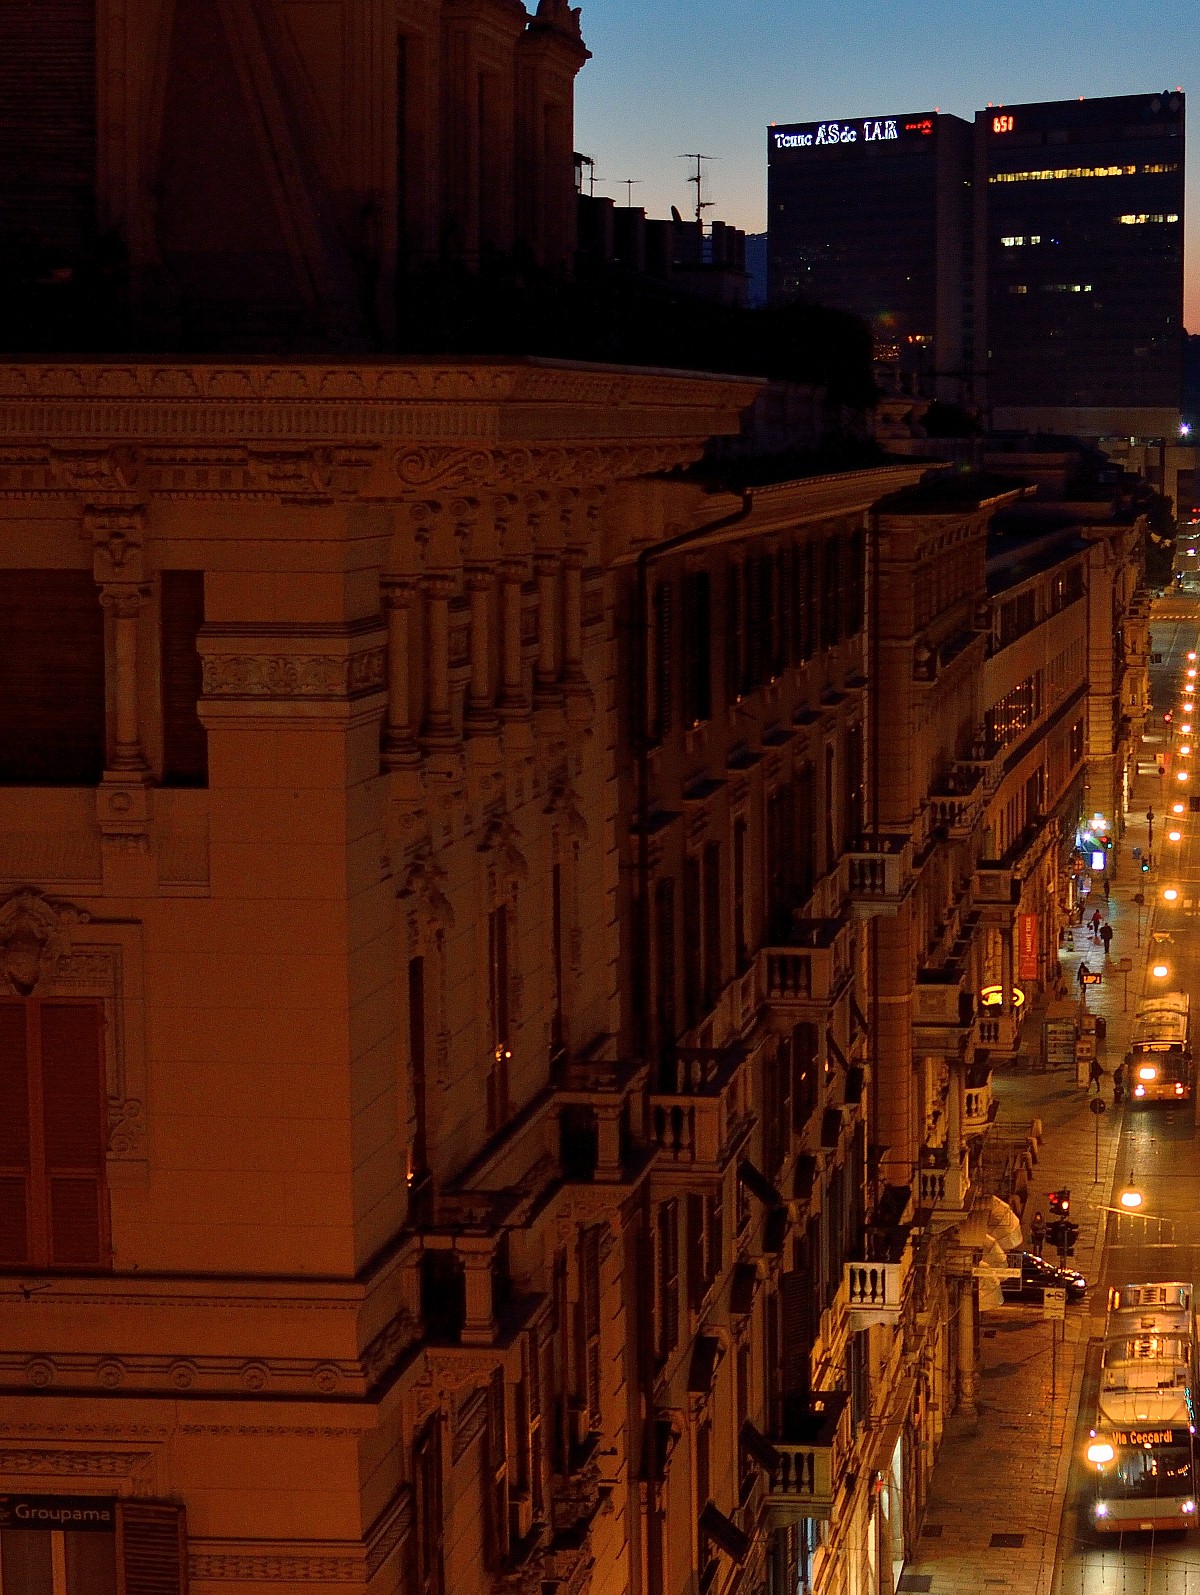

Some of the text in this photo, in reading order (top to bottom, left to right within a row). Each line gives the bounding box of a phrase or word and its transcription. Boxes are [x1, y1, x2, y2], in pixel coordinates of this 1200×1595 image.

[1112, 1429, 1173, 1445] Via Ceccardi
[15, 1503, 111, 1524] Groupama
